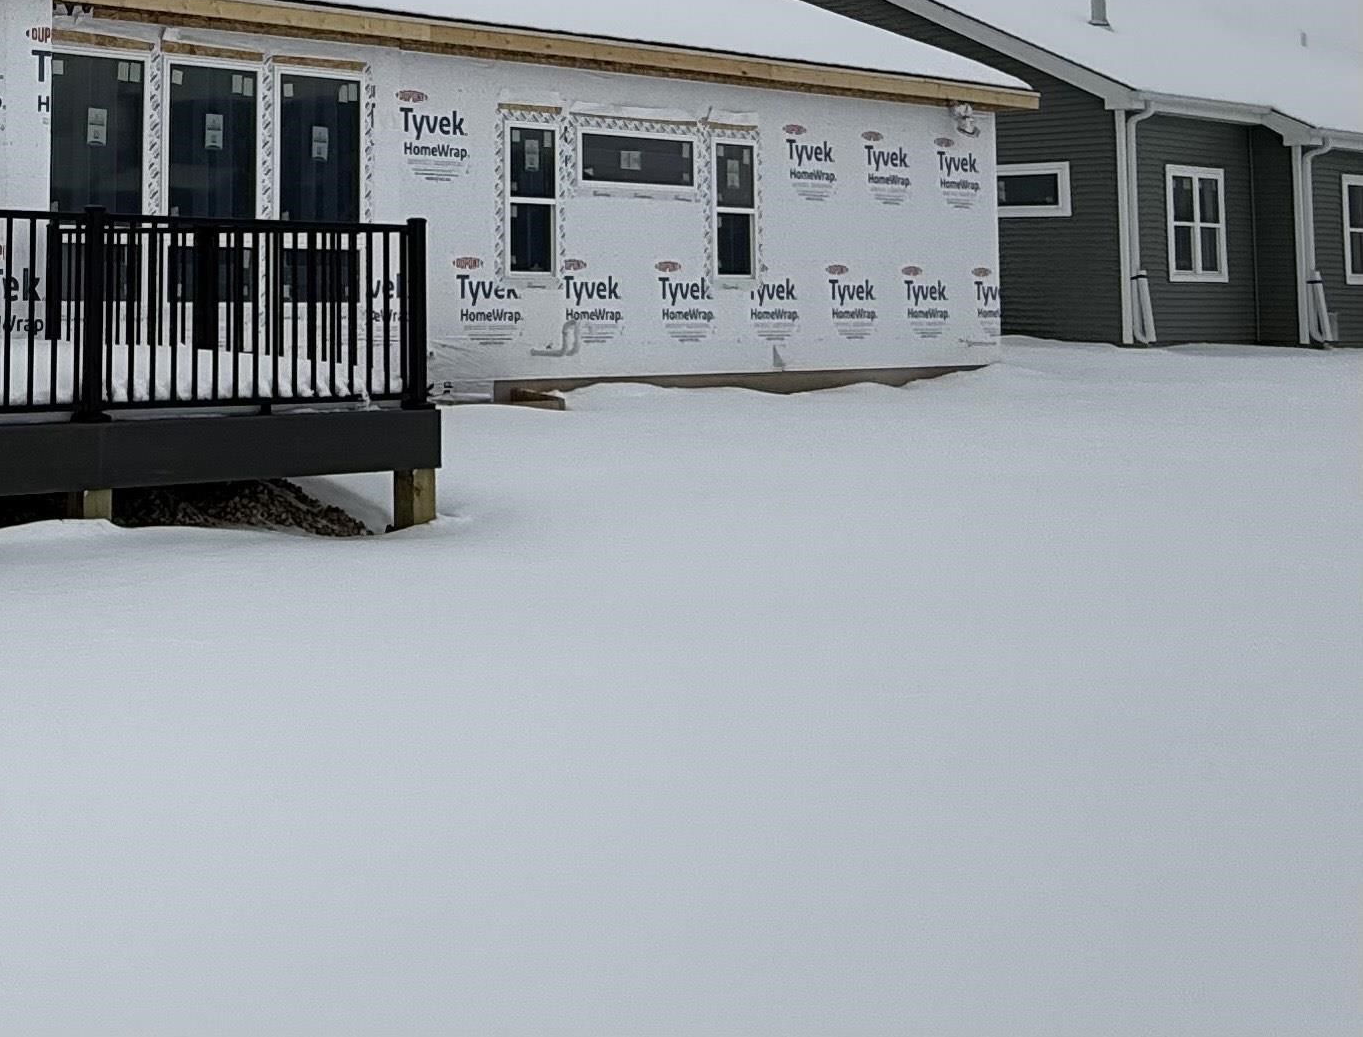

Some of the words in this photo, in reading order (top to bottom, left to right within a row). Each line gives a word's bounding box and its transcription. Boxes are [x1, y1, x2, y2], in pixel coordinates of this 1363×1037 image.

[399, 107, 464, 140] Tyvek
[404, 142, 467, 161] HomeWrap
[786, 139, 832, 166] Tyvek
[864, 145, 908, 171] Tyvek
[937, 151, 977, 177] Tyvek
[790, 168, 835, 183] HomeWrap
[868, 173, 910, 187] HomeWrap
[564, 276, 619, 306] Tyvek
[829, 279, 874, 306] Tyvek
[904, 280, 946, 306] Tyvek
[974, 281, 1000, 306] Tyv
[460, 309, 521, 324] HomeWrap
[566, 308, 621, 323] HomeWrap
[662, 308, 713, 322] HomeWrap
[750, 308, 798, 322] HomeWrap
[832, 308, 876, 321] HomeWrap
